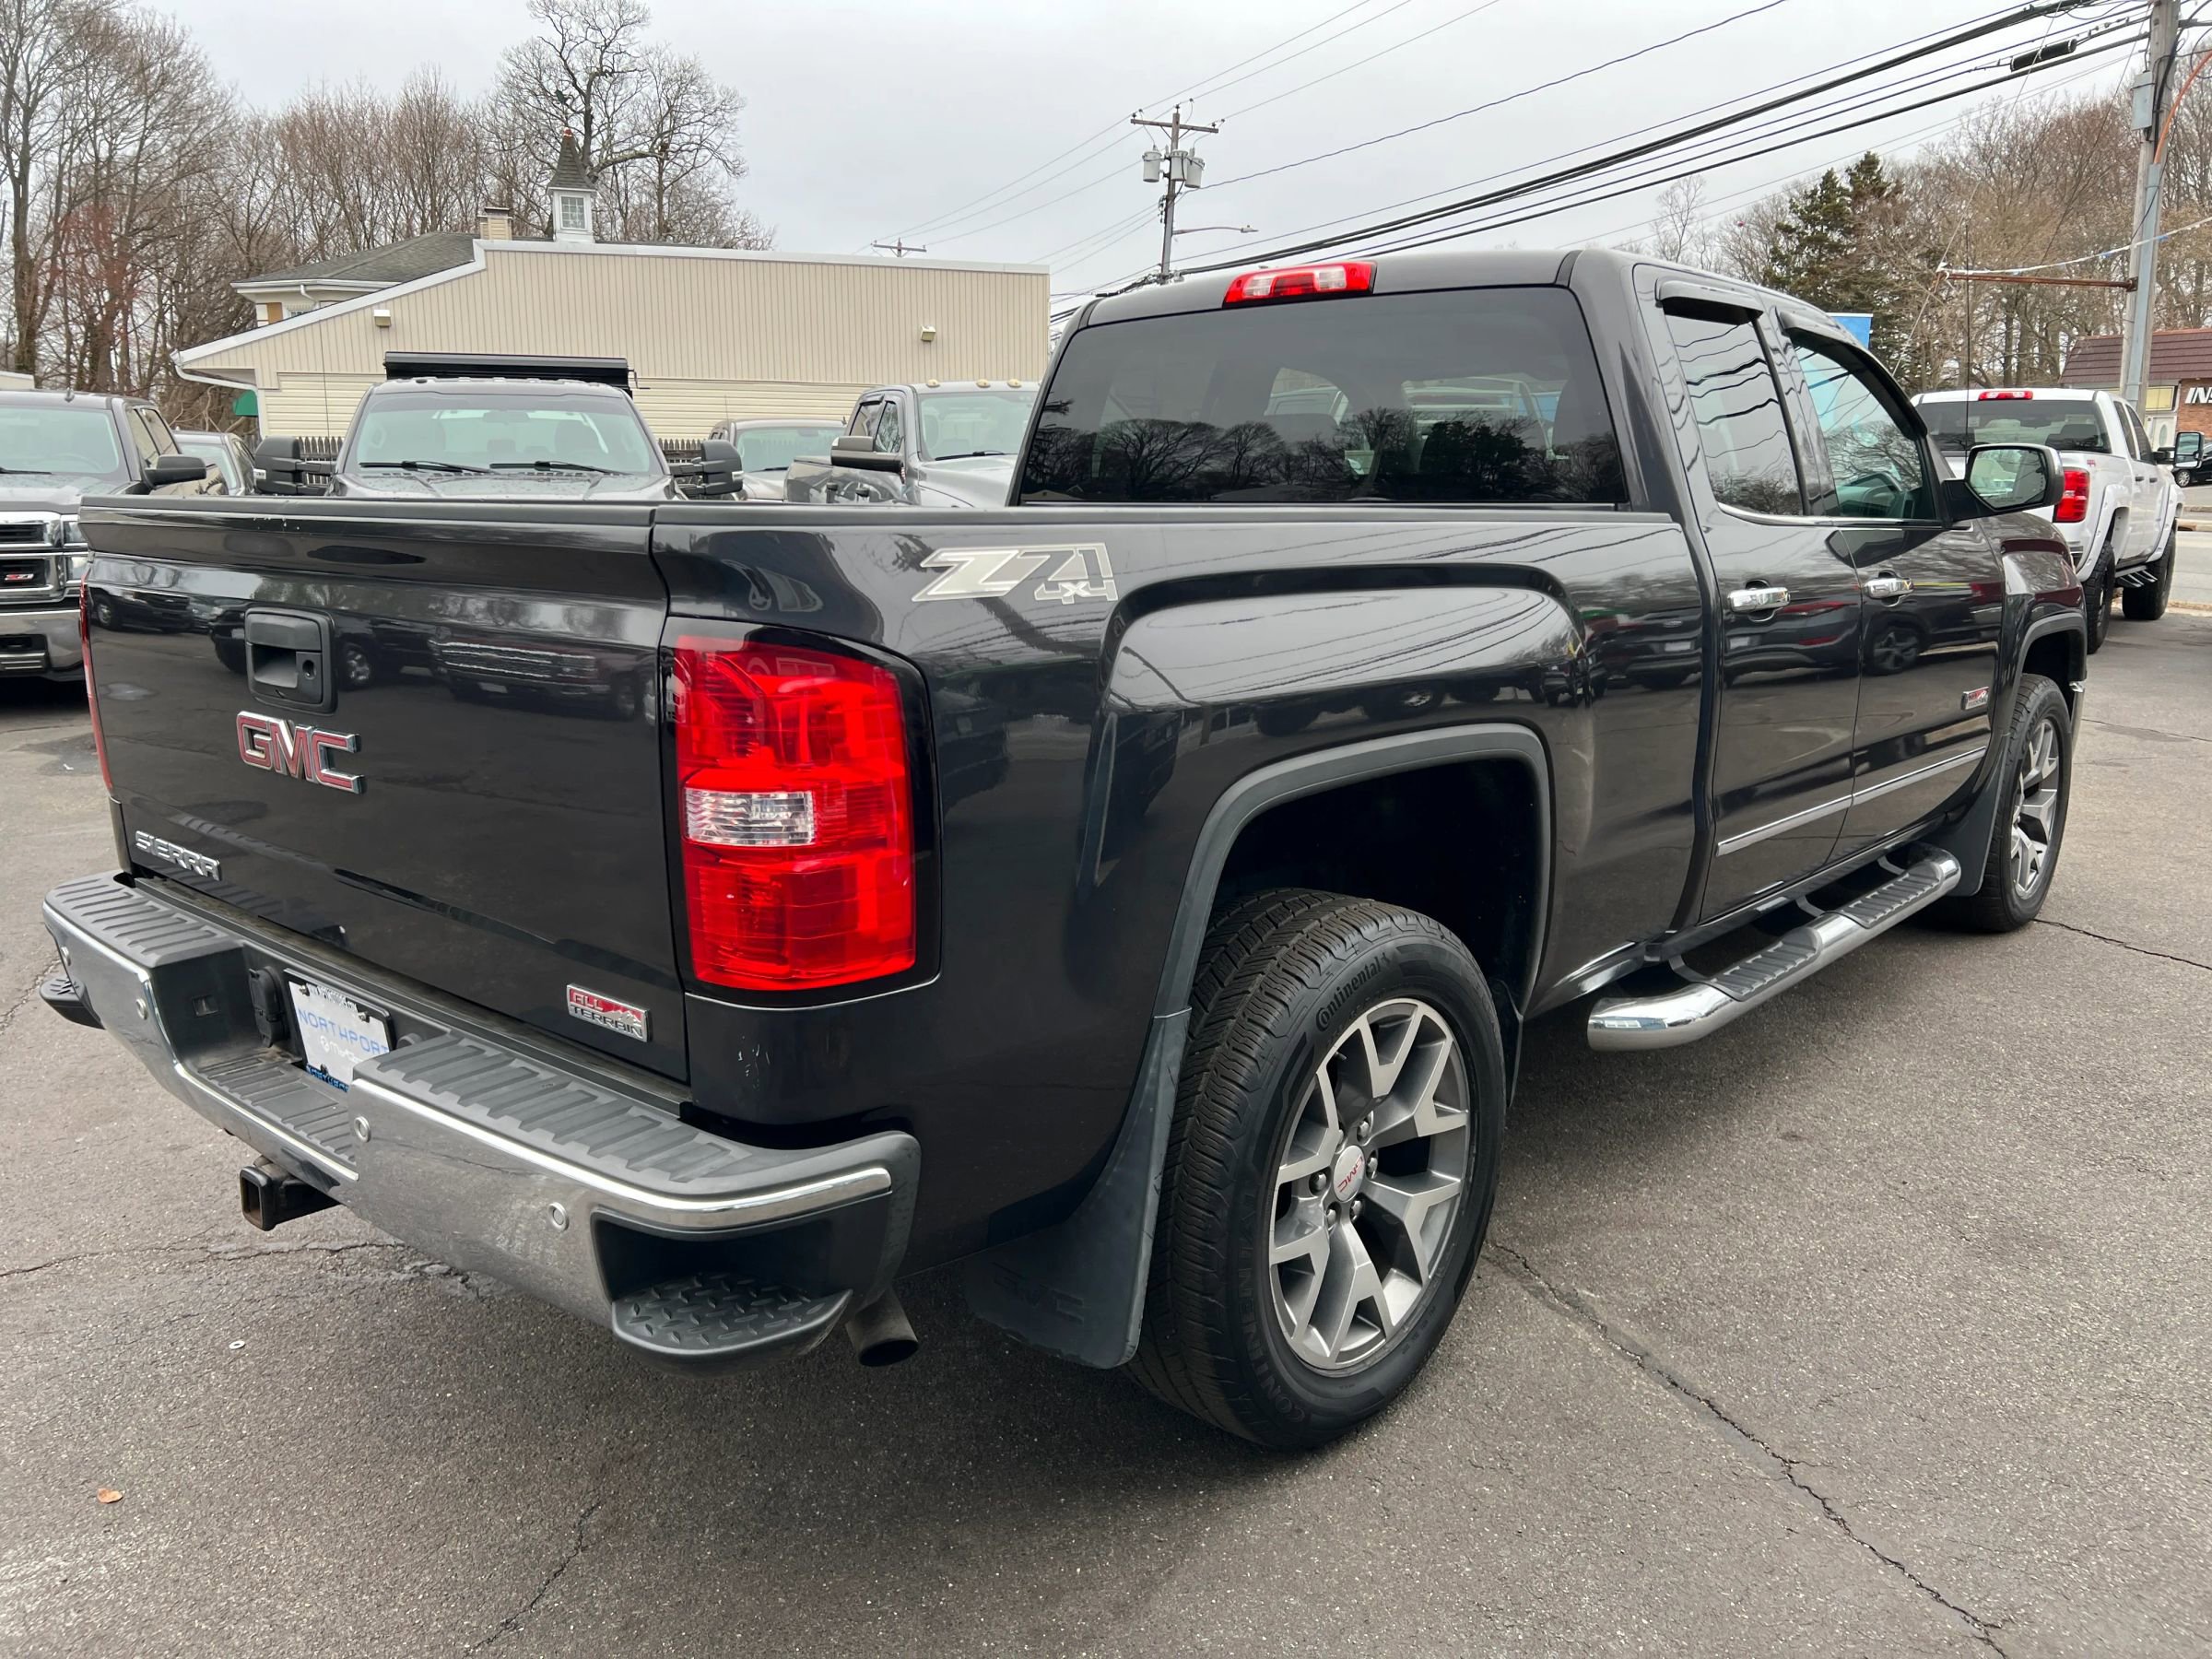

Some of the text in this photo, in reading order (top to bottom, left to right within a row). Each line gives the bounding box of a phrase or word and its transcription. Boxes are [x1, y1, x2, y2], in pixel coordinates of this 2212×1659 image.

[912, 543, 1113, 601] Z71
[236, 711, 362, 794] GMC
[135, 830, 220, 882] SIERRA
[572, 992, 604, 1012] ALL
[1315, 956, 1382, 1032] Continental
[570, 1004, 644, 1039] TERRAIN
[1337, 1154, 1363, 1193] GMC
